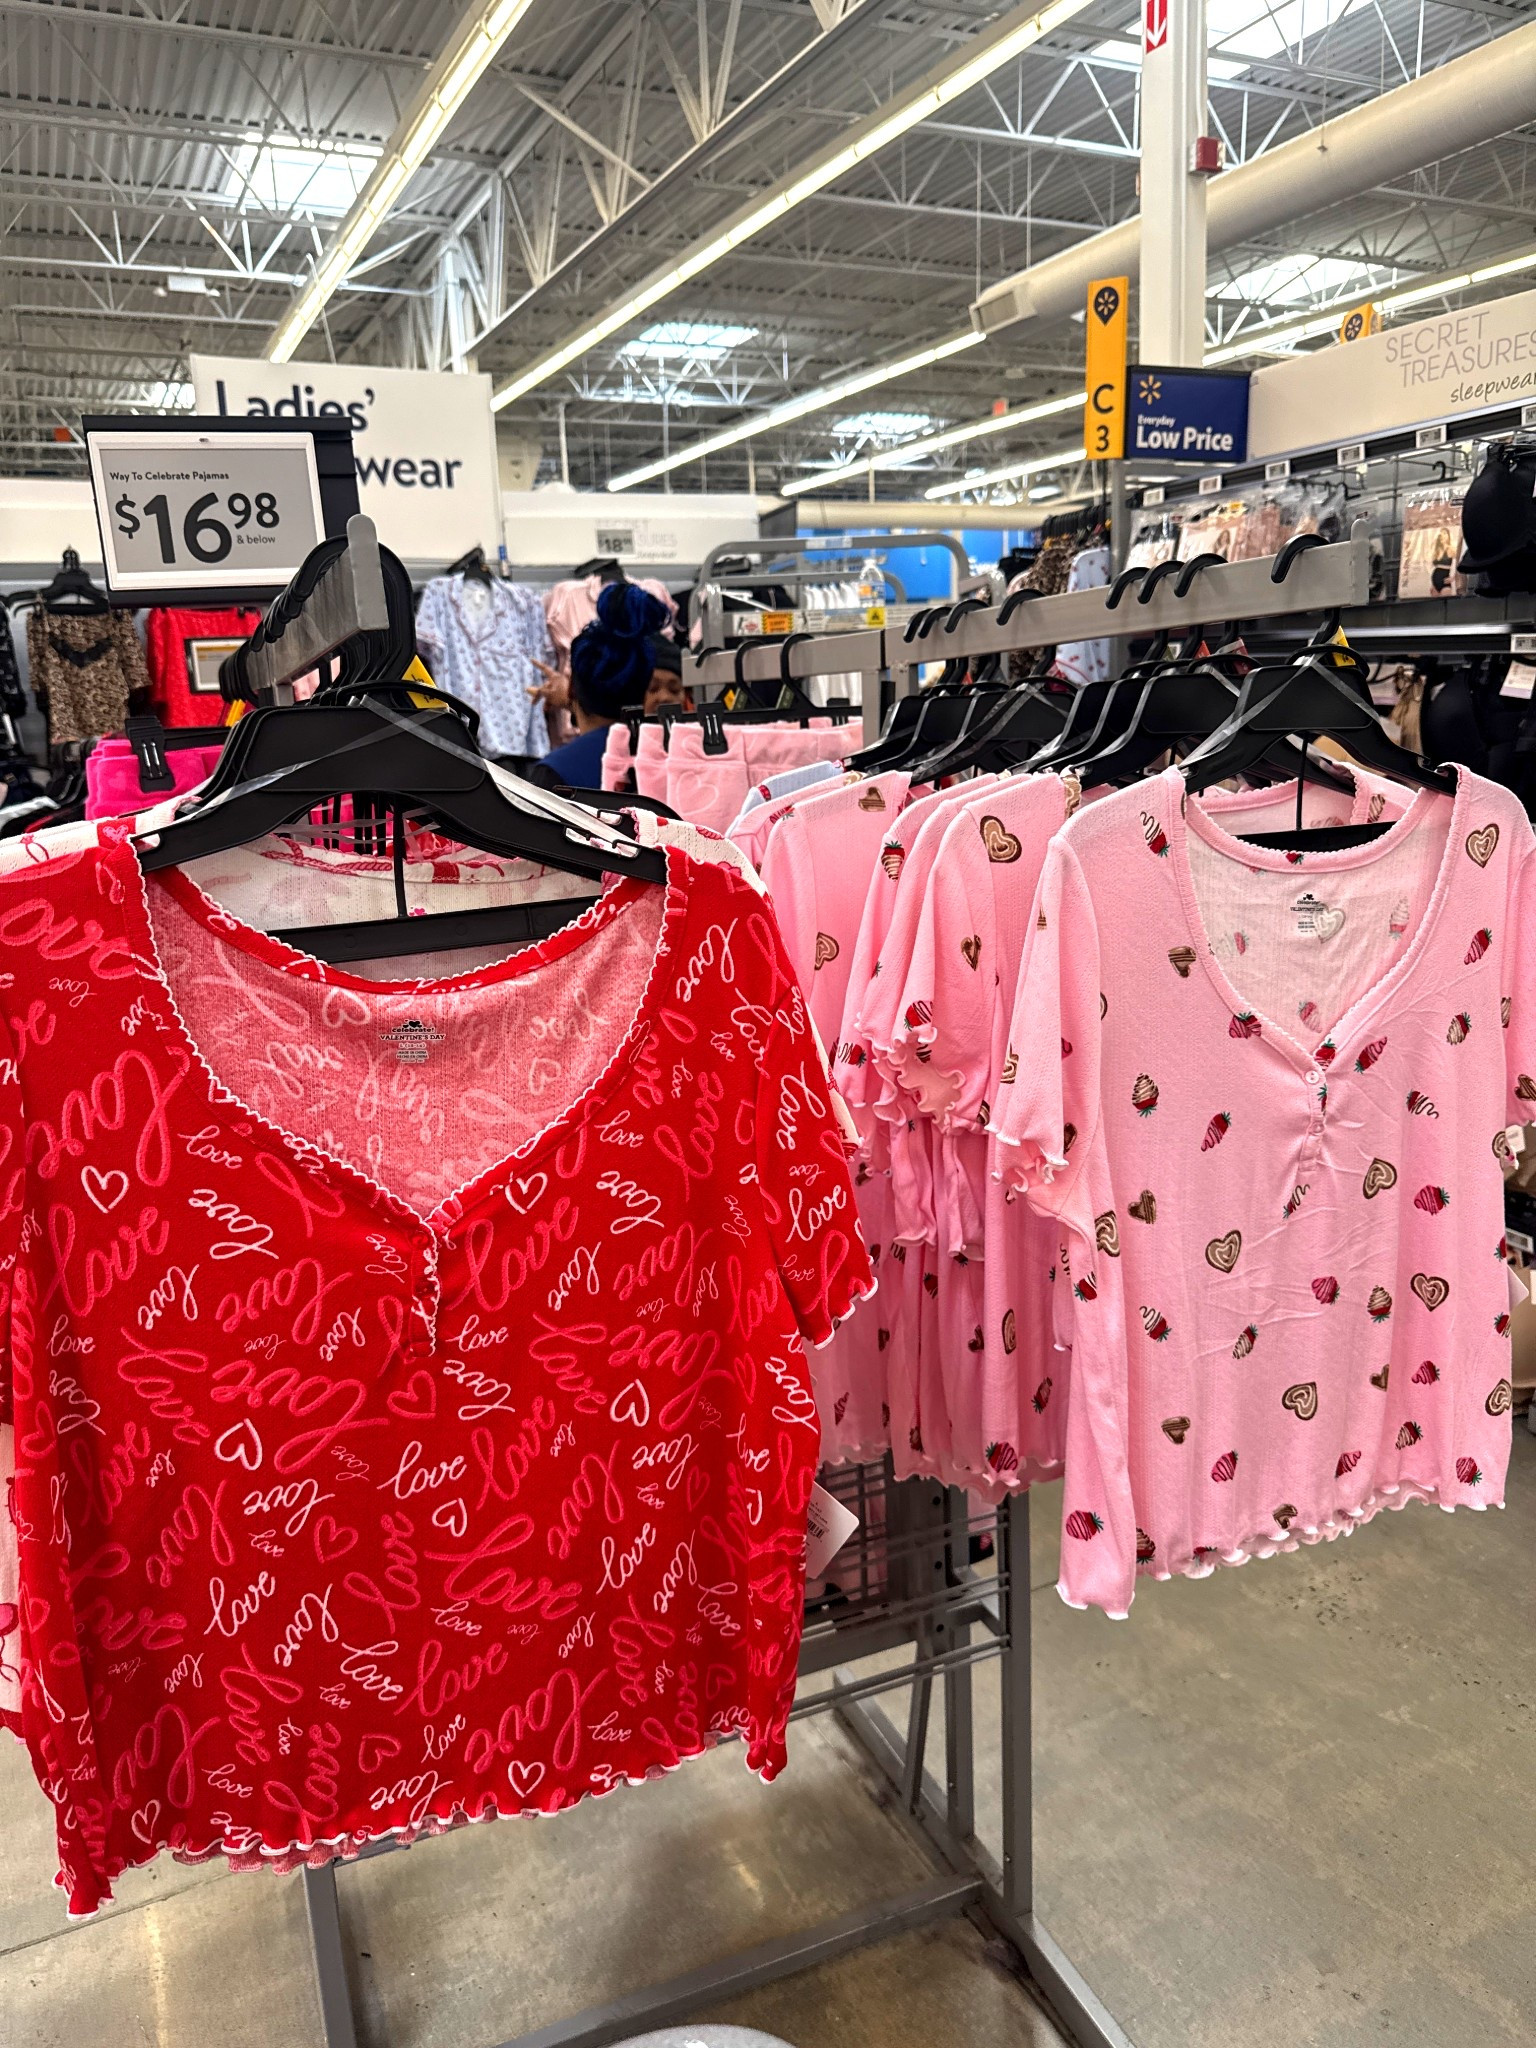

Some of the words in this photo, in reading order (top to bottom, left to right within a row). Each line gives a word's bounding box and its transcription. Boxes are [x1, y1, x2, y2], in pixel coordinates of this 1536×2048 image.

[1386, 311, 1490, 363] SECRET
[1093, 384, 1114, 413] C
[1137, 414, 1176, 428] Everyday
[1096, 425, 1109, 452] 3
[1136, 425, 1181, 449] Low
[1183, 426, 1234, 451] Price
[110, 471, 130, 482] Way
[132, 472, 143, 481] To
[145, 471, 191, 481] Celebrate
[193, 472, 230, 483] Pajamas
[236, 535, 245, 544] &
[247, 534, 276, 544] below
[676, 918, 738, 1003] love
[49, 977, 97, 1007] love
[776, 985, 805, 1044] love
[710, 1030, 735, 1062] love
[670, 1057, 693, 1099] love
[775, 1061, 826, 1150] love
[26, 1046, 190, 1187] love
[594, 1110, 645, 1148] love
[653, 1072, 724, 1202] love
[177, 1125, 242, 1169] love
[789, 1163, 825, 1187] love
[189, 1189, 279, 1259] love
[596, 1170, 664, 1235] love
[722, 1195, 751, 1249] love
[785, 1185, 846, 1243] love
[42, 1204, 169, 1317] love
[365, 1233, 407, 1283] love
[445, 1196, 579, 1311] love
[548, 1241, 601, 1311] love
[613, 1222, 713, 1307] love
[777, 1254, 815, 1281] love
[138, 1264, 200, 1330] love
[215, 1257, 353, 1345] love
[636, 1298, 671, 1323] love
[693, 1261, 719, 1317] love
[46, 1314, 96, 1356] love
[244, 1333, 287, 1360] love
[319, 1307, 366, 1361] love
[445, 1314, 509, 1352] love
[117, 1327, 210, 1445] love
[443, 1359, 516, 1421] love
[528, 1311, 607, 1414] love
[608, 1324, 735, 1431] love
[49, 1369, 106, 1436] love
[210, 1359, 389, 1474] love
[765, 1356, 818, 1435] love
[330, 1445, 370, 1481] love
[471, 1396, 556, 1511] love
[550, 1420, 575, 1457] love
[632, 1433, 699, 1490] love
[146, 1449, 175, 1488] love
[376, 1440, 467, 1499] love
[636, 1482, 664, 1509] love
[242, 1479, 335, 1537] love
[548, 1439, 624, 1559] love
[146, 1479, 235, 1588] love
[249, 1529, 284, 1557] love
[596, 1522, 656, 1595] love
[343, 1511, 421, 1634] love
[424, 1513, 583, 1621] love
[653, 1529, 698, 1614] love
[204, 1571, 275, 1637] love
[274, 1583, 339, 1667] love
[430, 1601, 482, 1636] love
[697, 1582, 741, 1637] love
[558, 1612, 595, 1659] love
[609, 1594, 675, 1707] love
[164, 1653, 204, 1693] love
[319, 1682, 351, 1709] love
[340, 1640, 403, 1701] love
[393, 1639, 508, 1717] love
[654, 1659, 675, 1695] love
[220, 1643, 303, 1765] love
[464, 1668, 609, 1775] love
[587, 1710, 632, 1742] love
[278, 1717, 303, 1755] love
[421, 1714, 466, 1764] love
[202, 1764, 253, 1798] love
